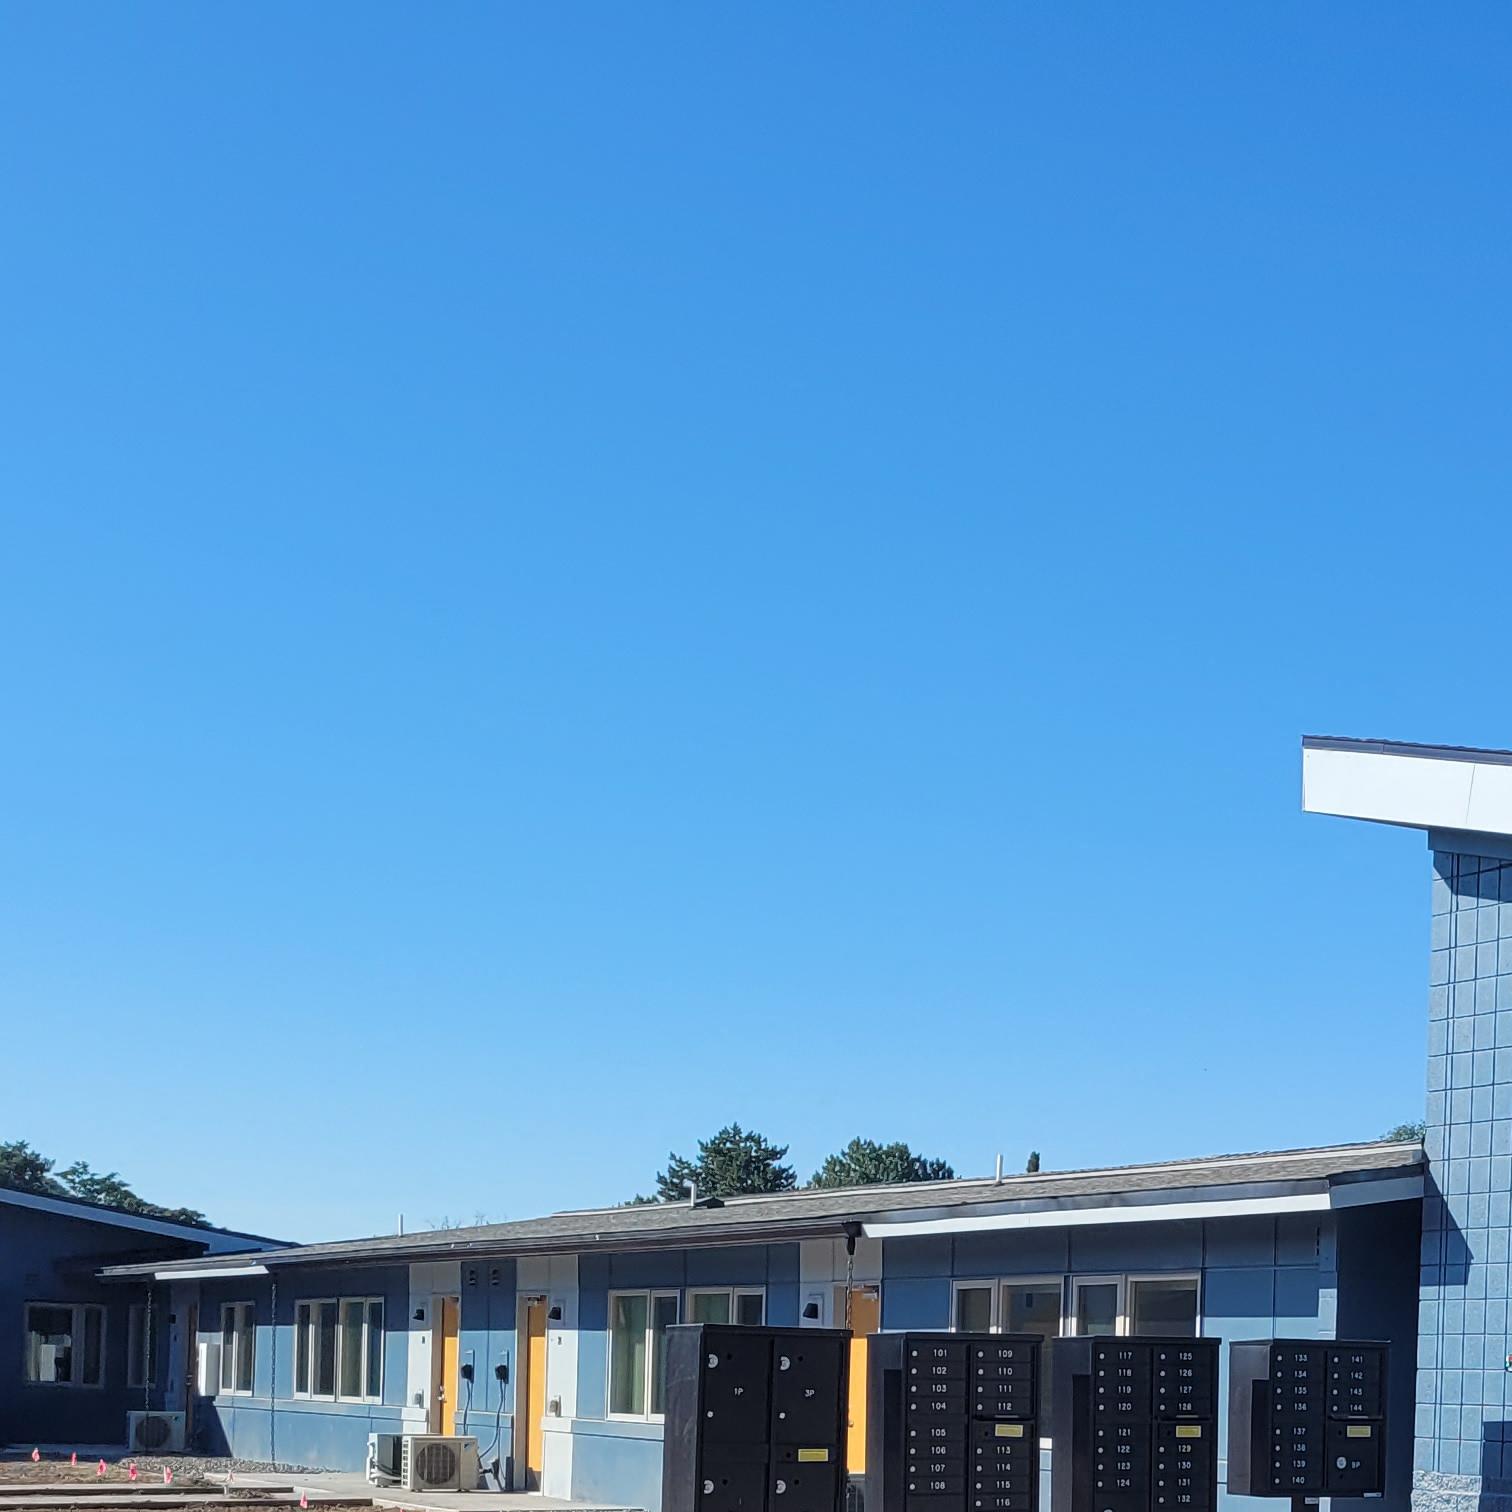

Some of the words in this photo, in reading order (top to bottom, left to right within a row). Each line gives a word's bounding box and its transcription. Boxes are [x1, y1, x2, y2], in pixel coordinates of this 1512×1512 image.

[933, 1348, 947, 1357] 101
[998, 1349, 1013, 1358] 109
[1119, 1351, 1133, 1360] 117
[1179, 1352, 1193, 1361] 125
[1351, 1355, 1363, 1364] 141
[932, 1366, 947, 1375] 102
[998, 1367, 1013, 1376] 110
[1350, 1371, 1363, 1380] 142
[734, 1387, 744, 1396] 1P
[932, 1384, 947, 1393] 103
[998, 1384, 1012, 1393] 111
[1179, 1385, 1193, 1394] 127
[804, 1389, 815, 1398] 3P
[931, 1401, 947, 1410] 104
[998, 1402, 1012, 1411] 112
[1118, 1402, 1132, 1411] 120
[1350, 1404, 1363, 1412] 144
[931, 1428, 947, 1437] 105
[1118, 1428, 1131, 1437] 121
[1293, 1427, 1306, 1435] 137
[931, 1446, 946, 1455] 106
[1117, 1445, 1131, 1454] 122
[930, 1463, 946, 1473] 107
[996, 1463, 1011, 1472] 114
[1117, 1461, 1131, 1470] 123
[1177, 1461, 1192, 1470] 130
[996, 1480, 1011, 1489] 115
[1116, 1478, 1130, 1487] 124
[1178, 1478, 1191, 1487] 131
[1292, 1476, 1305, 1485] 140
[930, 1481, 946, 1490] 108
[996, 1498, 1011, 1507] 116
[1177, 1494, 1191, 1503] 132
